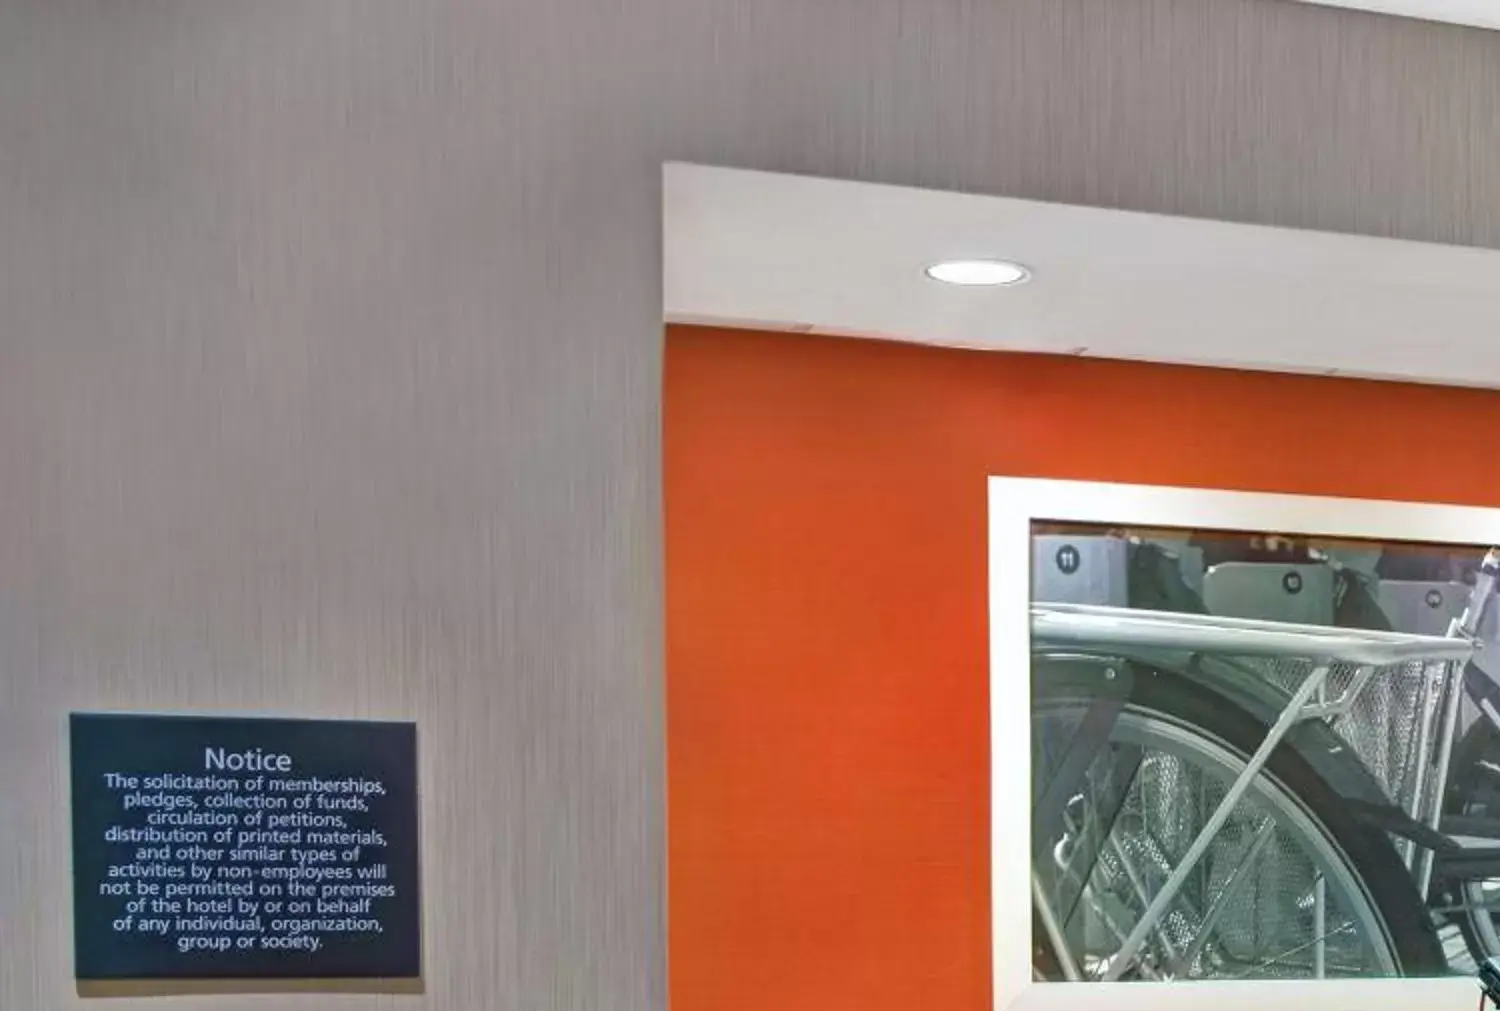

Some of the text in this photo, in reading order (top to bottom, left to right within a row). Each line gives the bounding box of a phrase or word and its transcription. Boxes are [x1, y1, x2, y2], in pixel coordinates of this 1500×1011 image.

[204, 747, 292, 772] Notice
[104, 772, 387, 797] The solicitation of memberships,
[123, 791, 369, 813] pledges, collection of funds,
[147, 810, 348, 829] circulation of petitions,
[104, 826, 388, 848] distribution of printed materials,
[135, 844, 361, 865] and other similar types of
[107, 862, 388, 882] activities by non-employees will
[99, 880, 396, 899] not be permitted on the premises
[126, 897, 373, 917] of the hotel by or on behalf
[113, 915, 384, 936] of any individual, organization,
[177, 934, 324, 952] group or society.
